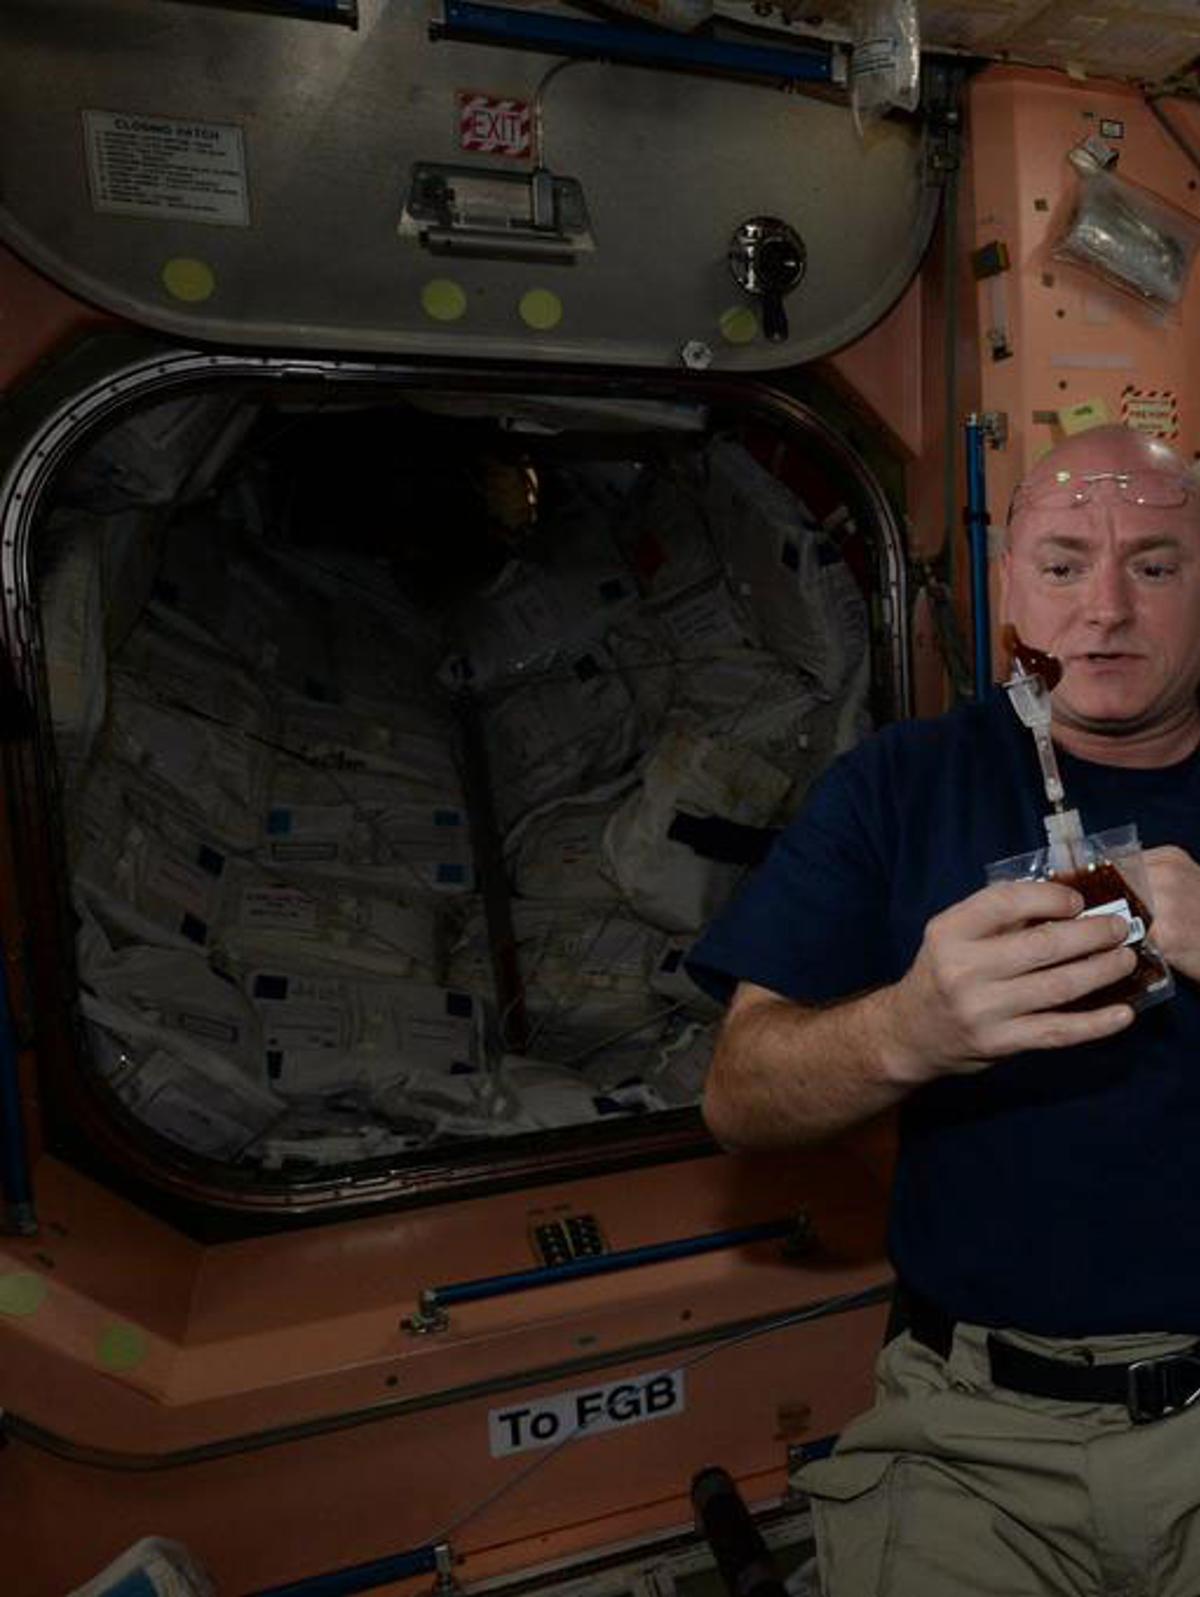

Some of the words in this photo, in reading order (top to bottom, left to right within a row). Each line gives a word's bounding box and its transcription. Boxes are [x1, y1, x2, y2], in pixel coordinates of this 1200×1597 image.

[473, 110, 521, 142] EXIT
[498, 1409, 560, 1446] To
[576, 1376, 677, 1428] FGB
